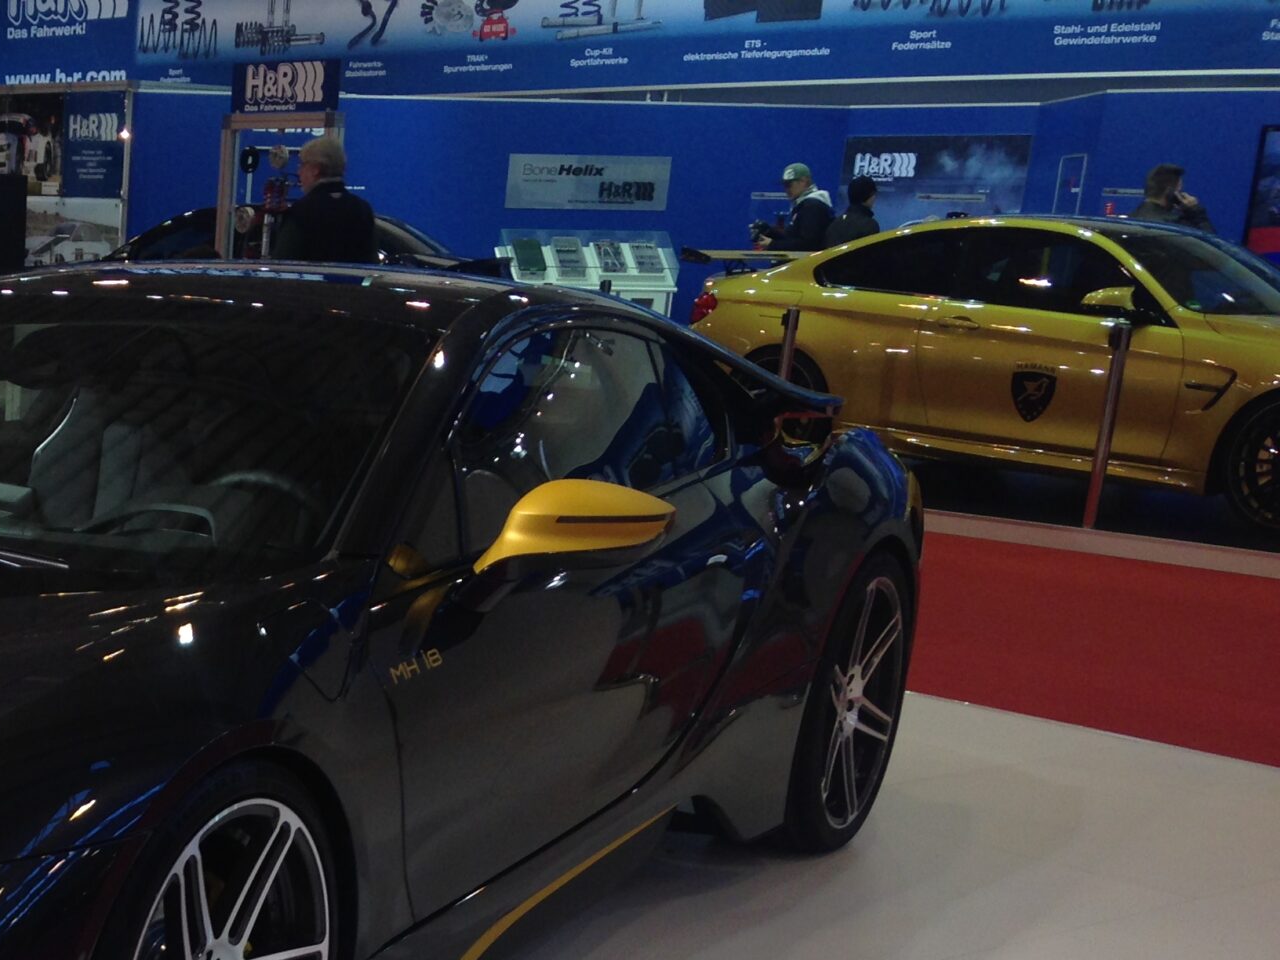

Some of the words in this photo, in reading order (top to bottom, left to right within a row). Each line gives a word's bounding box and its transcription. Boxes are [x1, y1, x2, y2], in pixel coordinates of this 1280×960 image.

[7, 27, 28, 39] Das
[30, 22, 86, 38] Fahrwerk!
[909, 30, 937, 40] Sport
[1053, 25, 1085, 35] Stahl-
[1087, 24, 1108, 34] und
[1110, 22, 1161, 33] Edelstahl
[744, 40, 761, 48] ETS
[891, 40, 952, 51] Federnsätze
[1053, 35, 1157, 46] Gewindefahrwerke
[245, 63, 297, 103] H&R
[68, 114, 99, 141] H&R
[853, 153, 893, 177] H&R
[389, 657, 421, 685] MH
